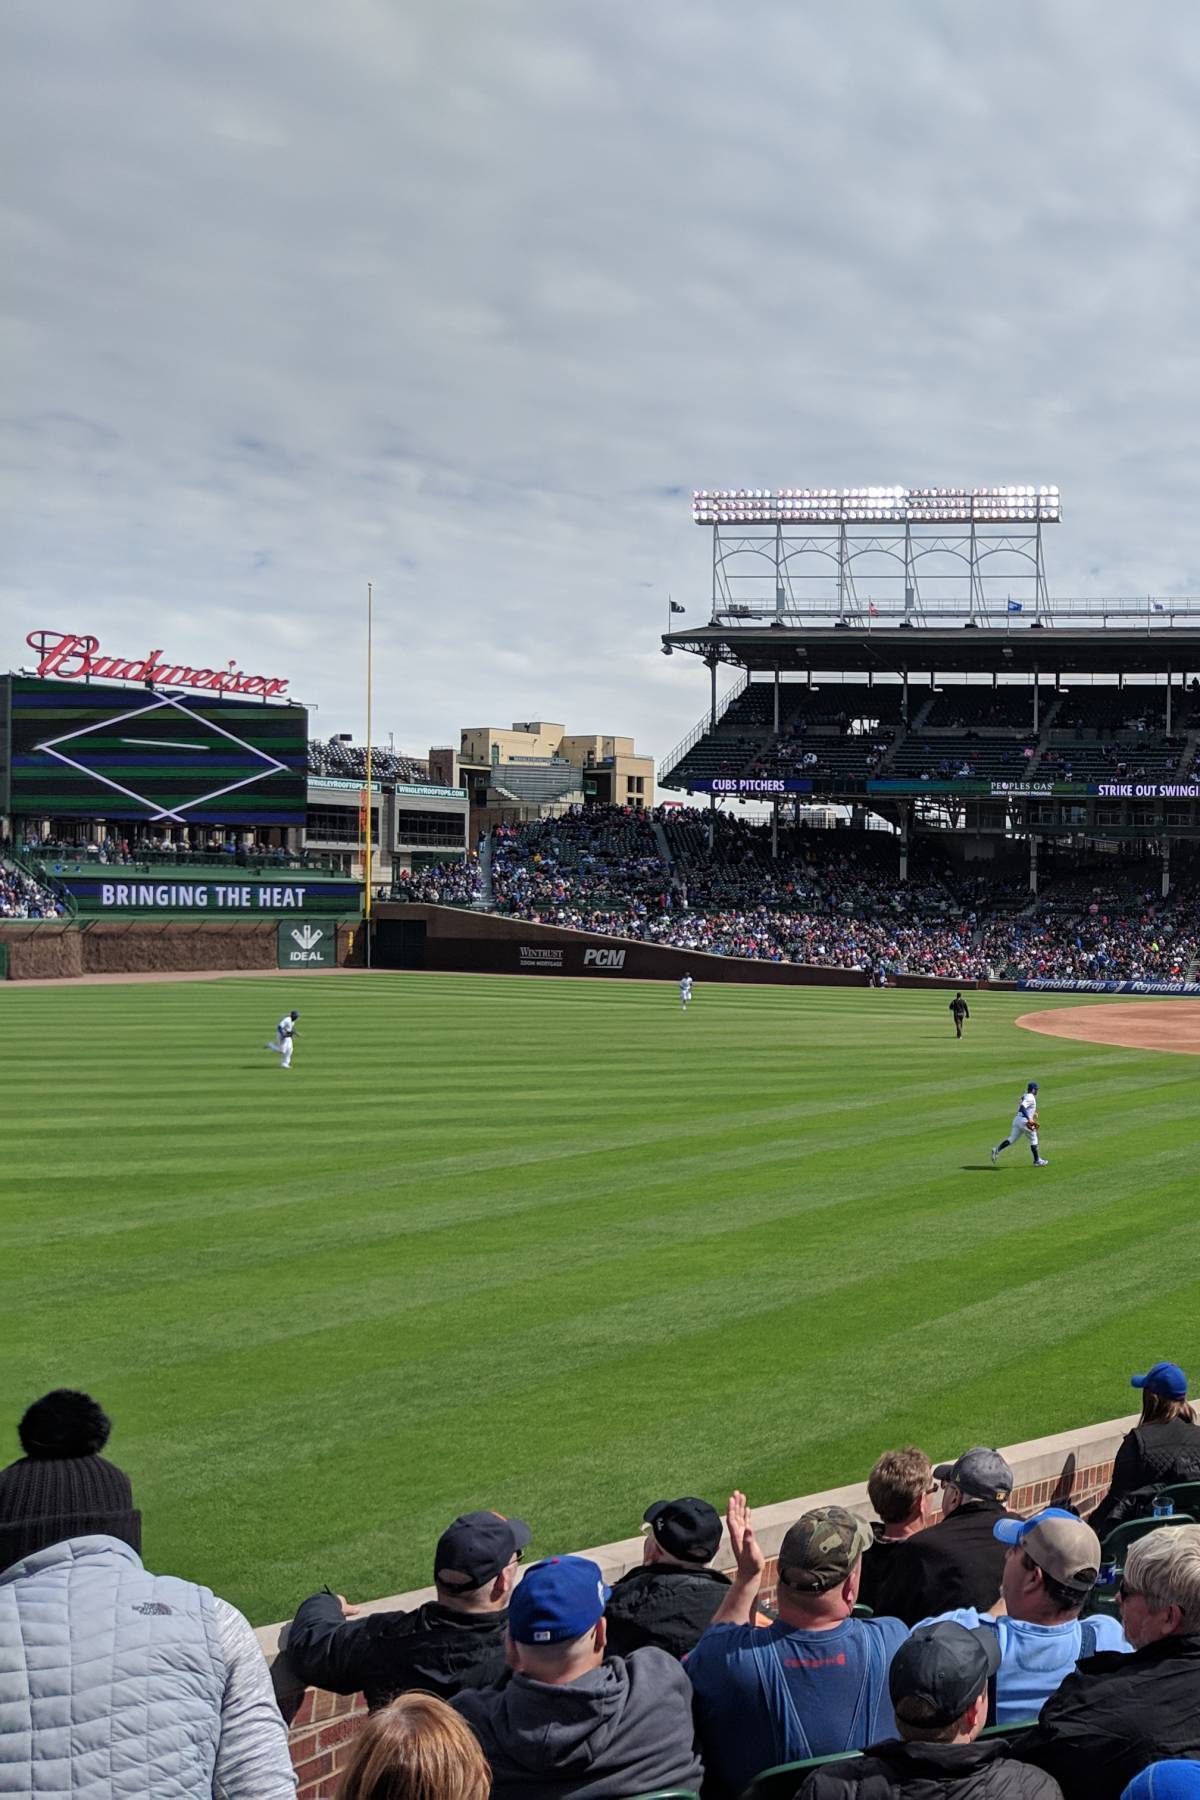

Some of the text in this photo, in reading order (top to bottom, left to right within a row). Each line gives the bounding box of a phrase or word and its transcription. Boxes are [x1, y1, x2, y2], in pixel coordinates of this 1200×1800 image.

[26, 630, 290, 697] Budweiser
[712, 779, 785, 792] CUBS PITCHERS
[991, 782, 1053, 790] PEOPLES GAS
[1098, 785, 1133, 796] STRIKE
[1135, 785, 1157, 796] OUT
[101, 884, 306, 908] BRINGING THE HEAT
[290, 951, 324, 962] IDEAL
[583, 948, 626, 966] PCM
[1025, 979, 1106, 992] Reynolds Wrap
[1131, 981, 1183, 994] Reynolds
